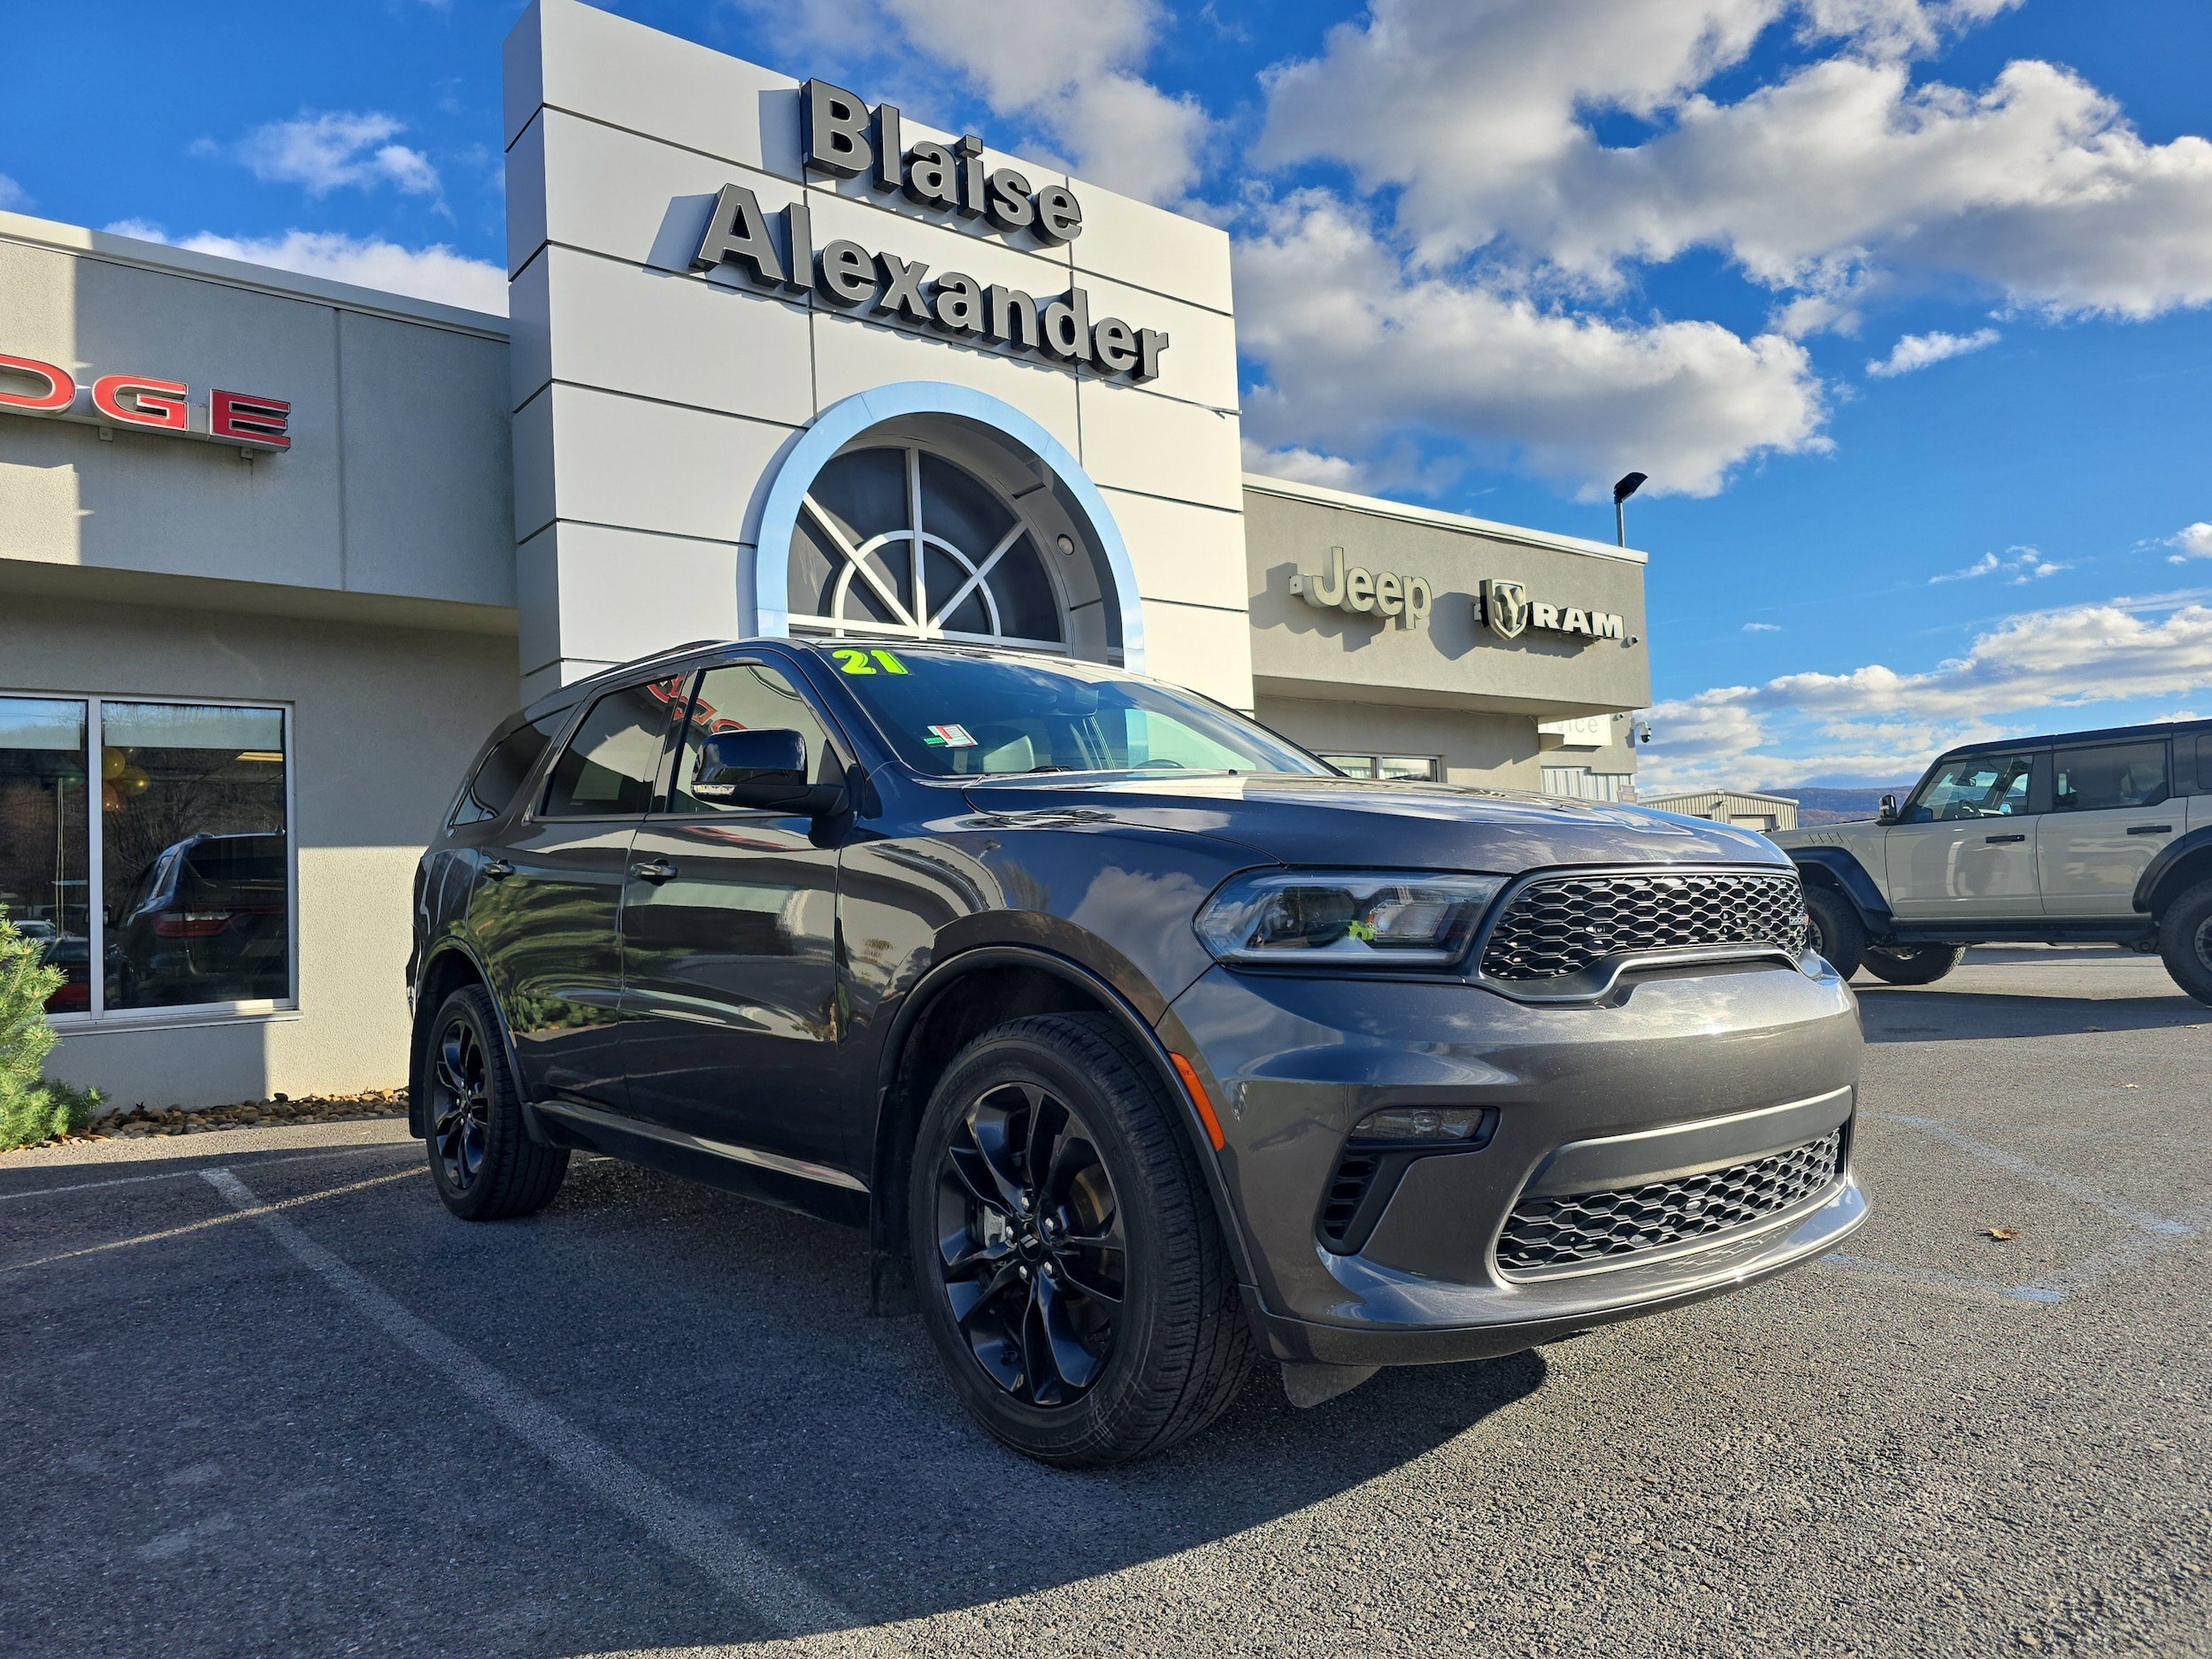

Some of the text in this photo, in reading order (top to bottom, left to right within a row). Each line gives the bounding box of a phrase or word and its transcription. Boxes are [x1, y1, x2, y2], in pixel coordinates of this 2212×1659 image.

[802, 77, 1082, 245] Blaise
[691, 183, 1169, 382] Alexander
[1304, 546, 1432, 629] Jeep
[1532, 602, 1624, 639] RAM
[833, 649, 909, 674] 21
